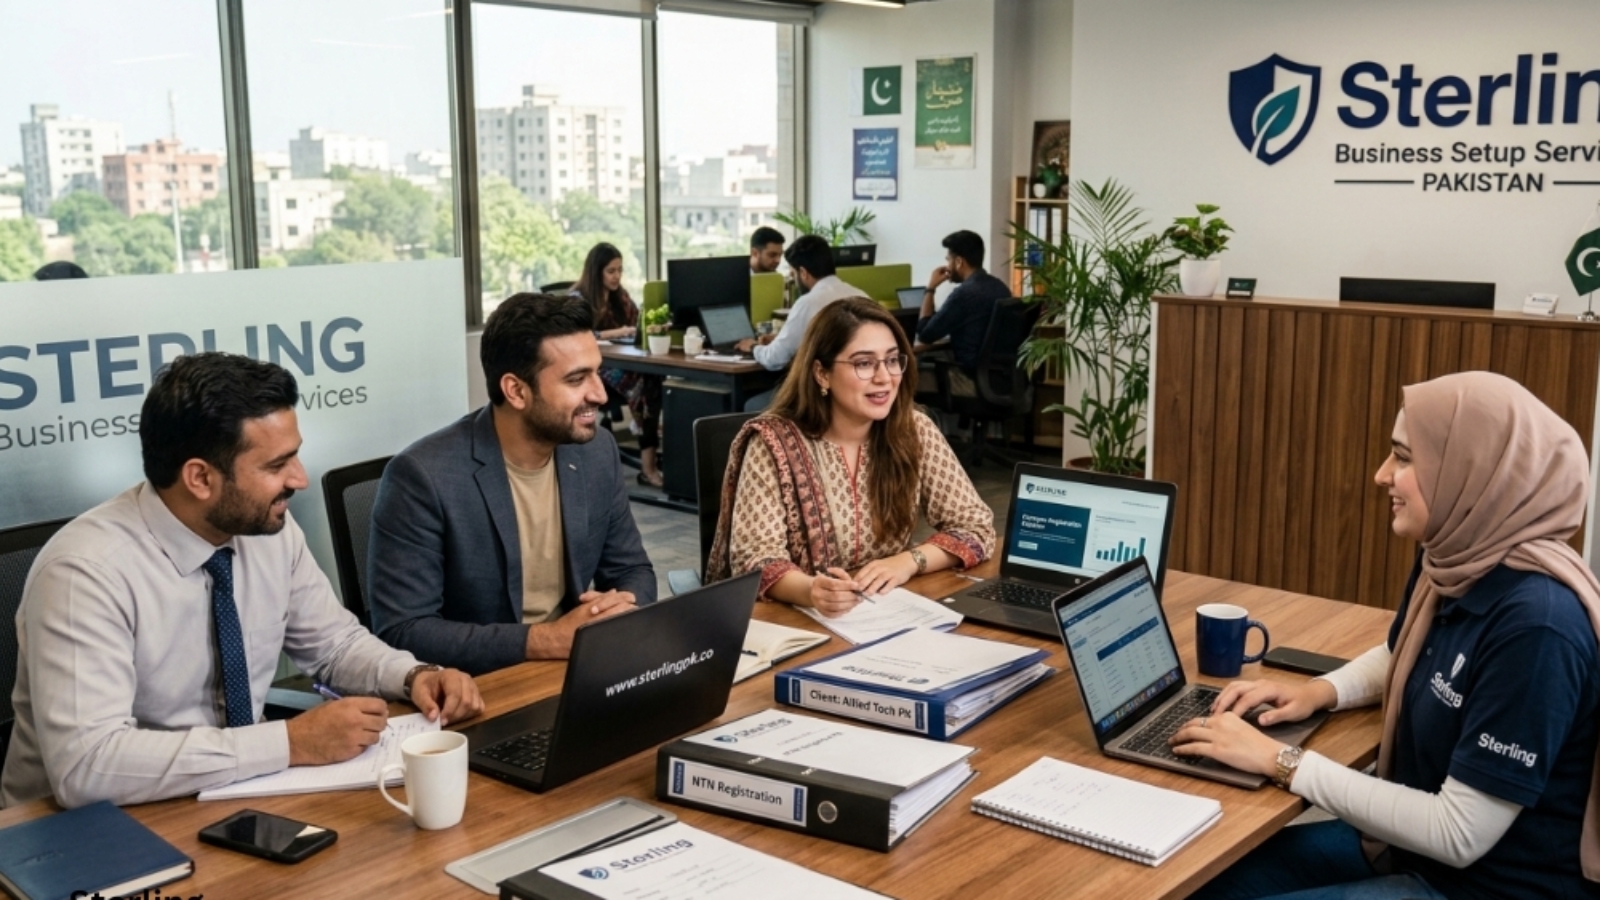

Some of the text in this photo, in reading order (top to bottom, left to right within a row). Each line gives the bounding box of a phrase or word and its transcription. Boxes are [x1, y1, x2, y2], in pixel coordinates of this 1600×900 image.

[1337, 52, 1600, 129] Sterlin
[1334, 139, 1600, 168] Business Setup Servi
[1422, 172, 1544, 192] PAKISTAN
[0, 316, 366, 410] STERING
[0, 385, 367, 451] Business vices
[605, 648, 714, 697] www.sterlingpk.co
[809, 689, 841, 705] Client:
[842, 696, 871, 711] Allied
[1477, 732, 1538, 768] Sterling
[692, 775, 715, 791] NTN
[717, 781, 782, 805] Registration
